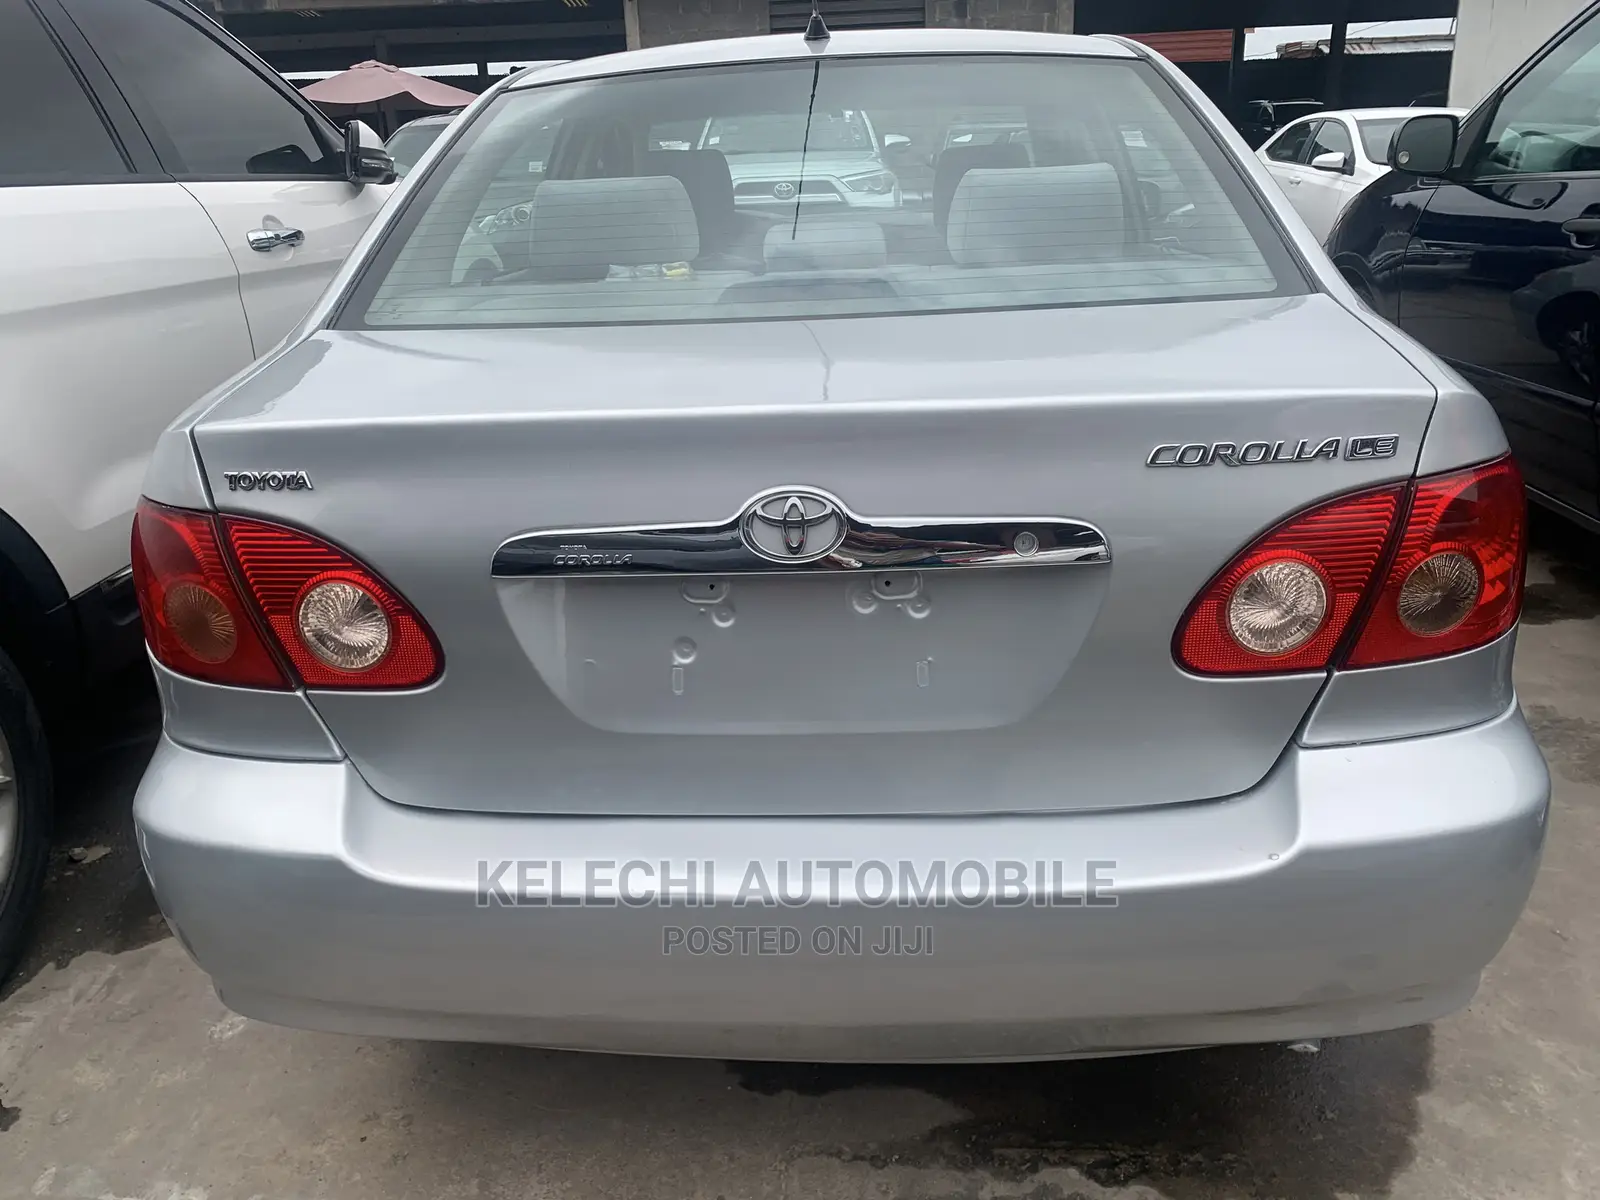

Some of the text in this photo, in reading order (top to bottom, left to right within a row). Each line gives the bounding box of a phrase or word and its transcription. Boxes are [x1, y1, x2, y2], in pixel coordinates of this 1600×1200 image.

[1146, 436, 1397, 467] COROLLA LE
[223, 470, 313, 491] TOYOTA
[553, 553, 633, 566] COROLLA
